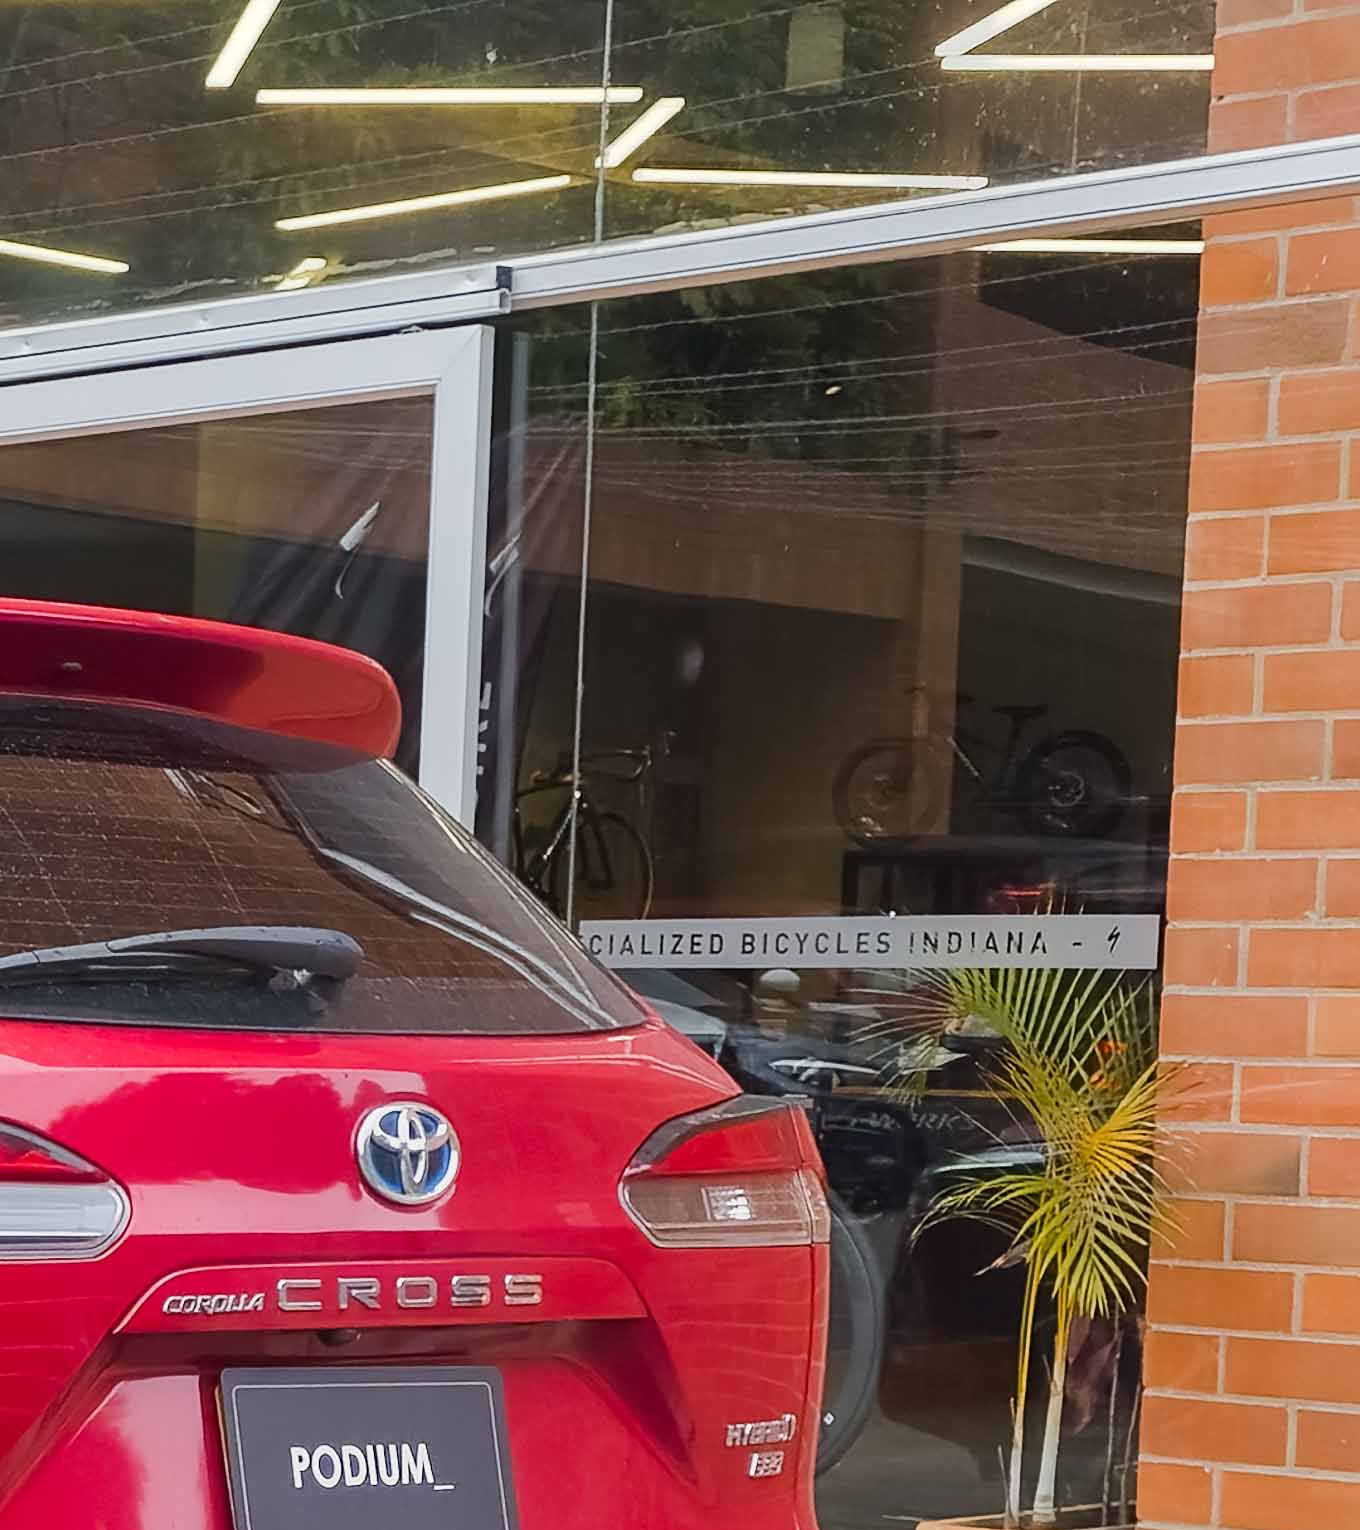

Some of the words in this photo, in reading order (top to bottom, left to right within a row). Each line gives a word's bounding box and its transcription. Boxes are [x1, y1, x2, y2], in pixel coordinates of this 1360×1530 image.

[580, 933, 724, 956] CIALIZED
[741, 932, 891, 955] BICYCLES
[909, 931, 1048, 955] INDIANA
[162, 1293, 265, 1315] COROLLA
[276, 1274, 544, 1312] CROSS
